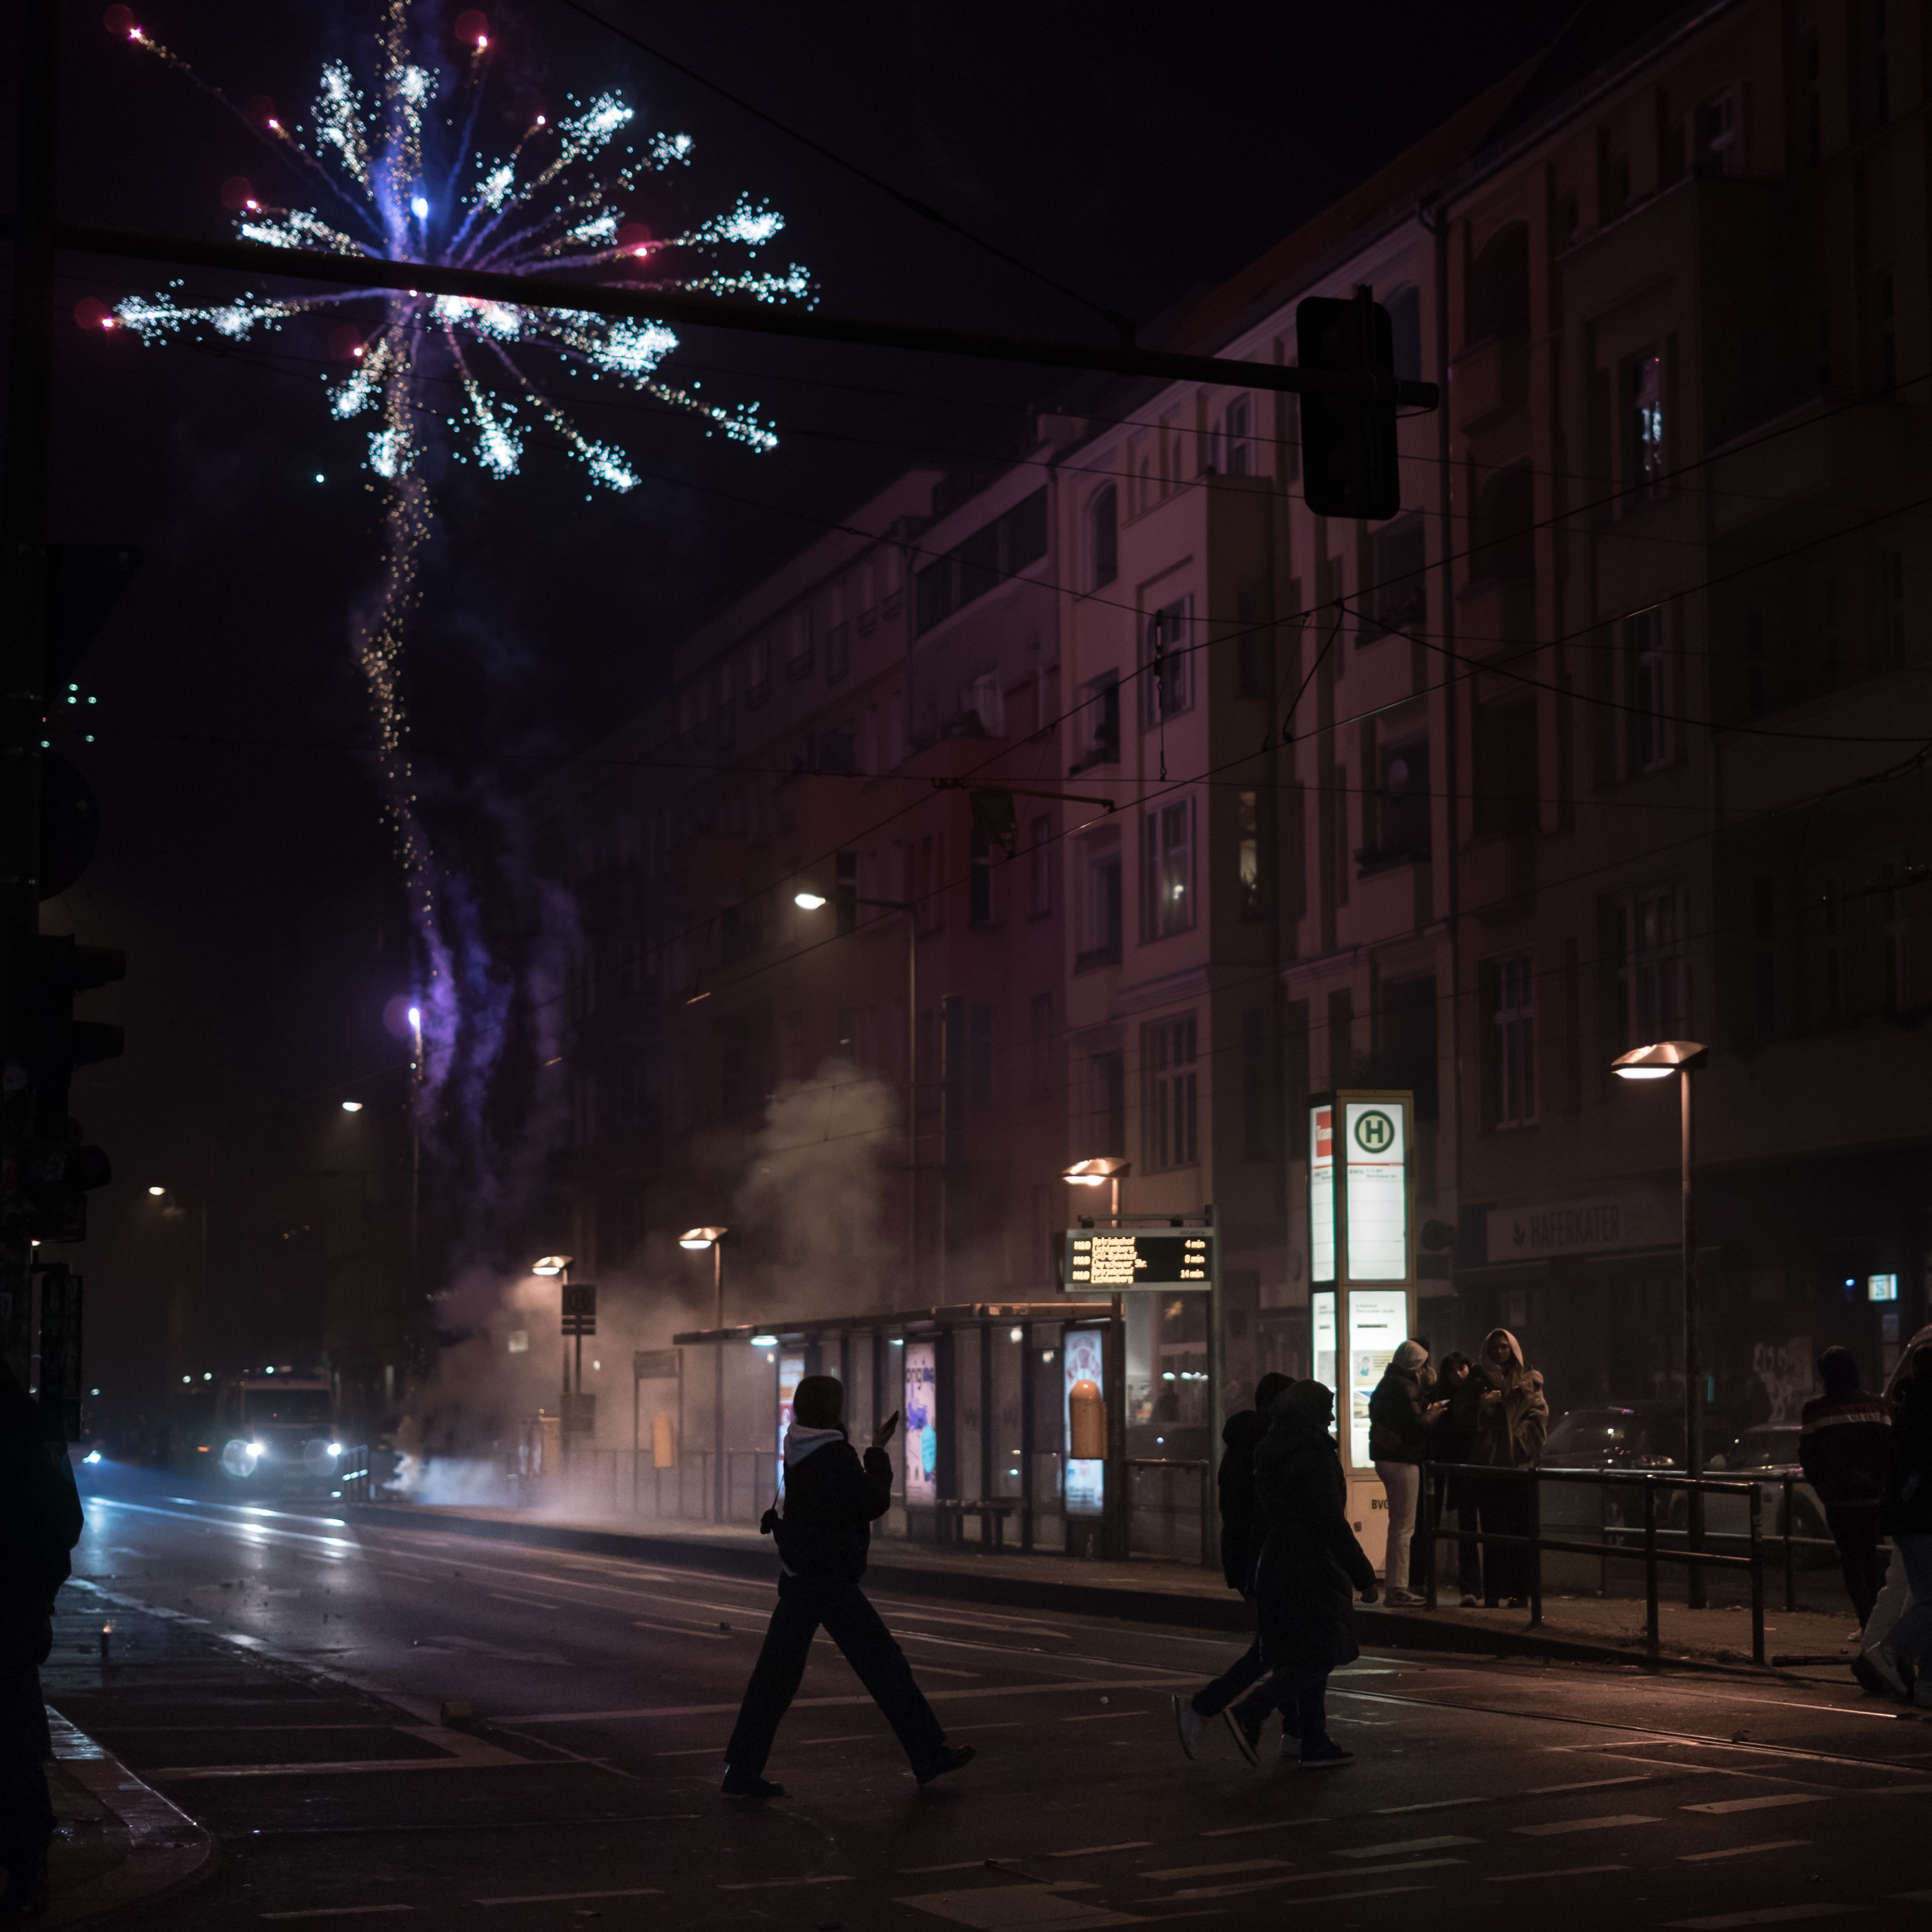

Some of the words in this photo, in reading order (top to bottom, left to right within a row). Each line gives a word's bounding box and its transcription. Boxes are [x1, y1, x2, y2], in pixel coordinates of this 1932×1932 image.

[1365, 1119, 1384, 1144] H
[1530, 1204, 1620, 1247] HAFERKATER
[1185, 1240, 1191, 1248] 4
[1191, 1240, 1205, 1248] min
[1190, 1255, 1204, 1263] min
[1180, 1269, 1189, 1278] 14
[1189, 1269, 1204, 1278] min
